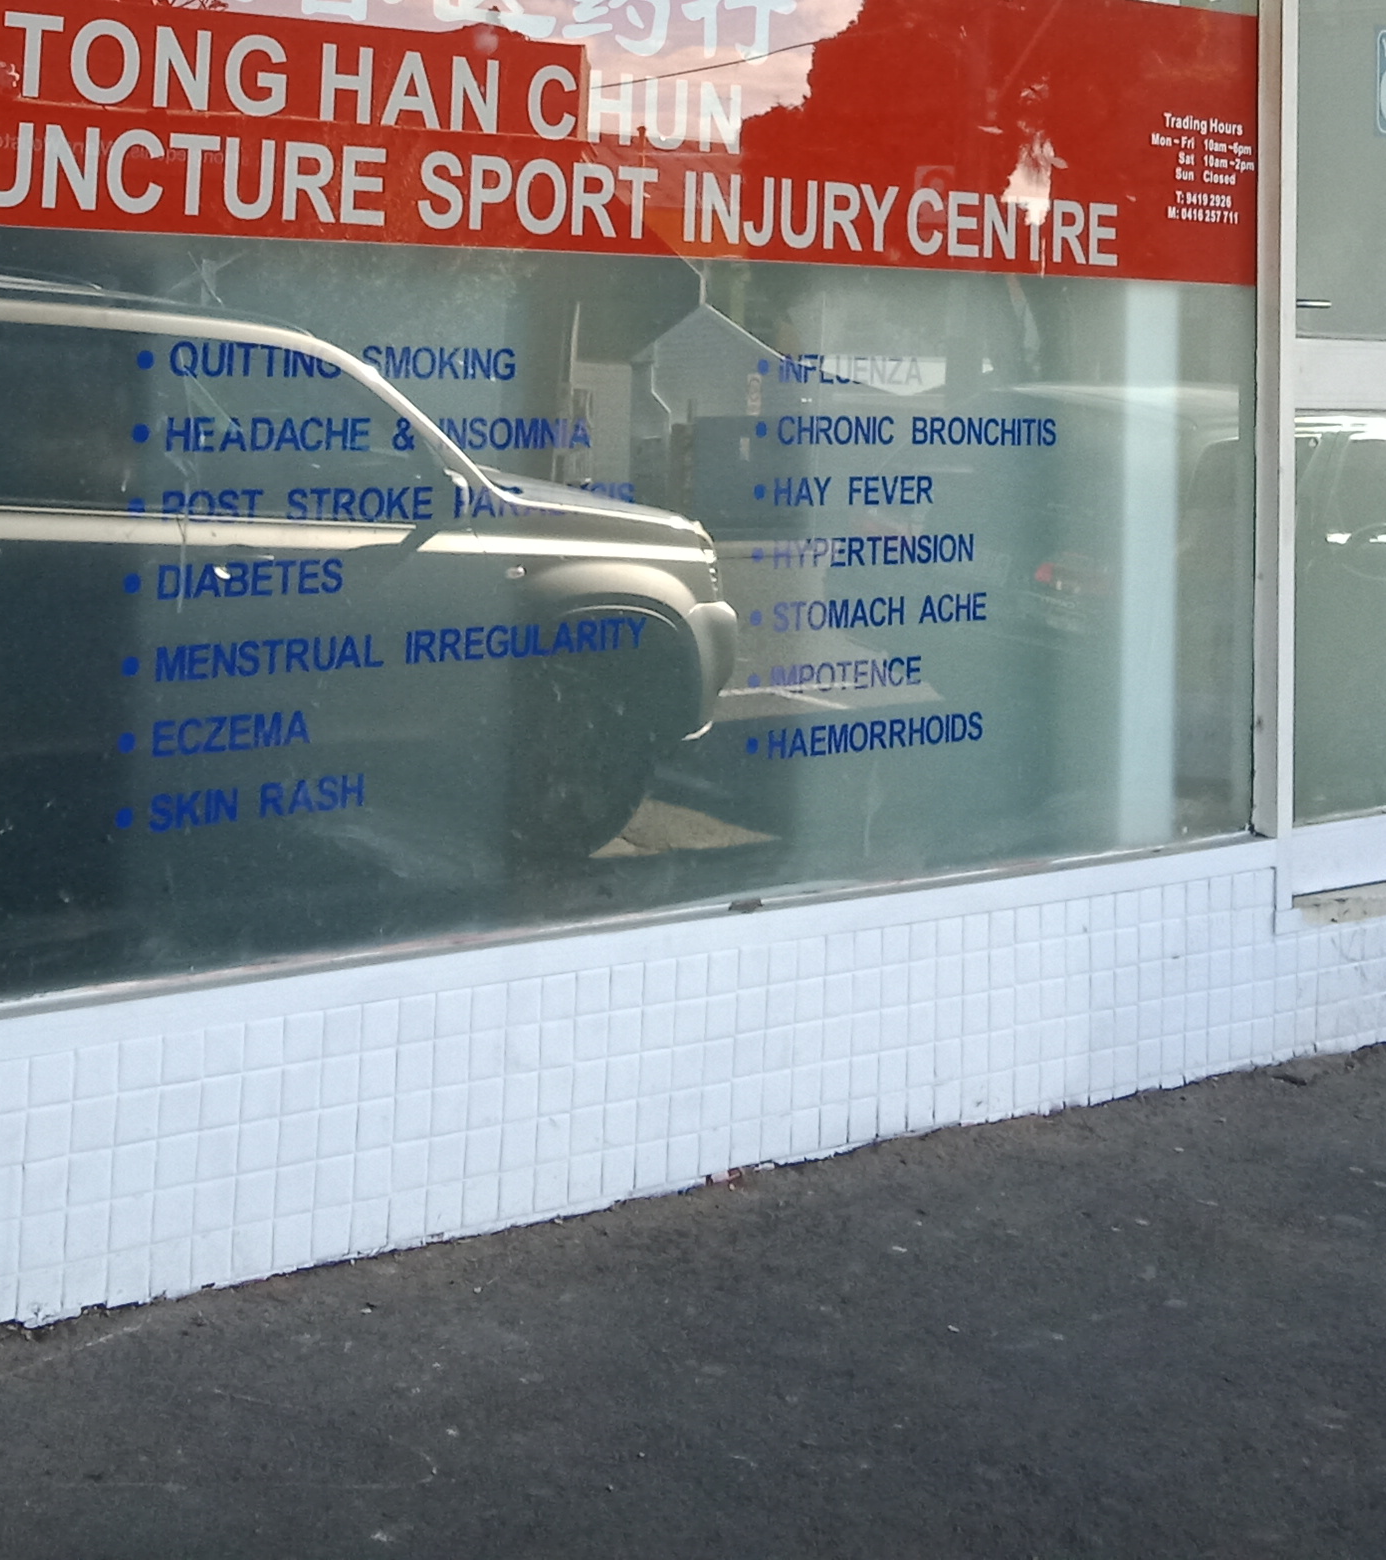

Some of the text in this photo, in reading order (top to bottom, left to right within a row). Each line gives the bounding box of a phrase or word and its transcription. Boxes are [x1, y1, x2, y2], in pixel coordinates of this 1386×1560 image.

[3, 10, 743, 155] TONG HAN CHUN
[1151, 133, 1173, 147] Mon
[1181, 136, 1196, 150] Fri
[1163, 112, 1244, 137] Trading Hours
[1175, 167, 1237, 186] Sun Closed
[1178, 151, 1196, 166] Sat
[417, 150, 659, 241] SPORT
[681, 169, 900, 253] INJURY
[906, 187, 1120, 268] CENTRE
[1186, 192, 1209, 207] 9419
[1205, 210, 1222, 224] 257
[168, 341, 517, 382] QUITTING SMOKING
[777, 353, 923, 387] INFLUENZA
[163, 416, 593, 454] HEADACHE & INSOMNIA
[776, 414, 1058, 448] CHRONIC BRONCHITIS
[160, 488, 264, 525] POST
[286, 485, 434, 523] STROKE
[773, 475, 934, 508] HAY FEVER
[771, 532, 975, 570] HYPERTENSION
[156, 557, 345, 602] DIABETES
[771, 591, 988, 634] STOMACH ACHE
[154, 616, 649, 685] MENSTRUAL IRREGULARITY
[770, 655, 923, 695] IMPOTENCE
[150, 710, 312, 760] ECZEMA
[765, 711, 984, 761] HAEMORRHOIDS
[147, 772, 367, 835] SKIN RASH
